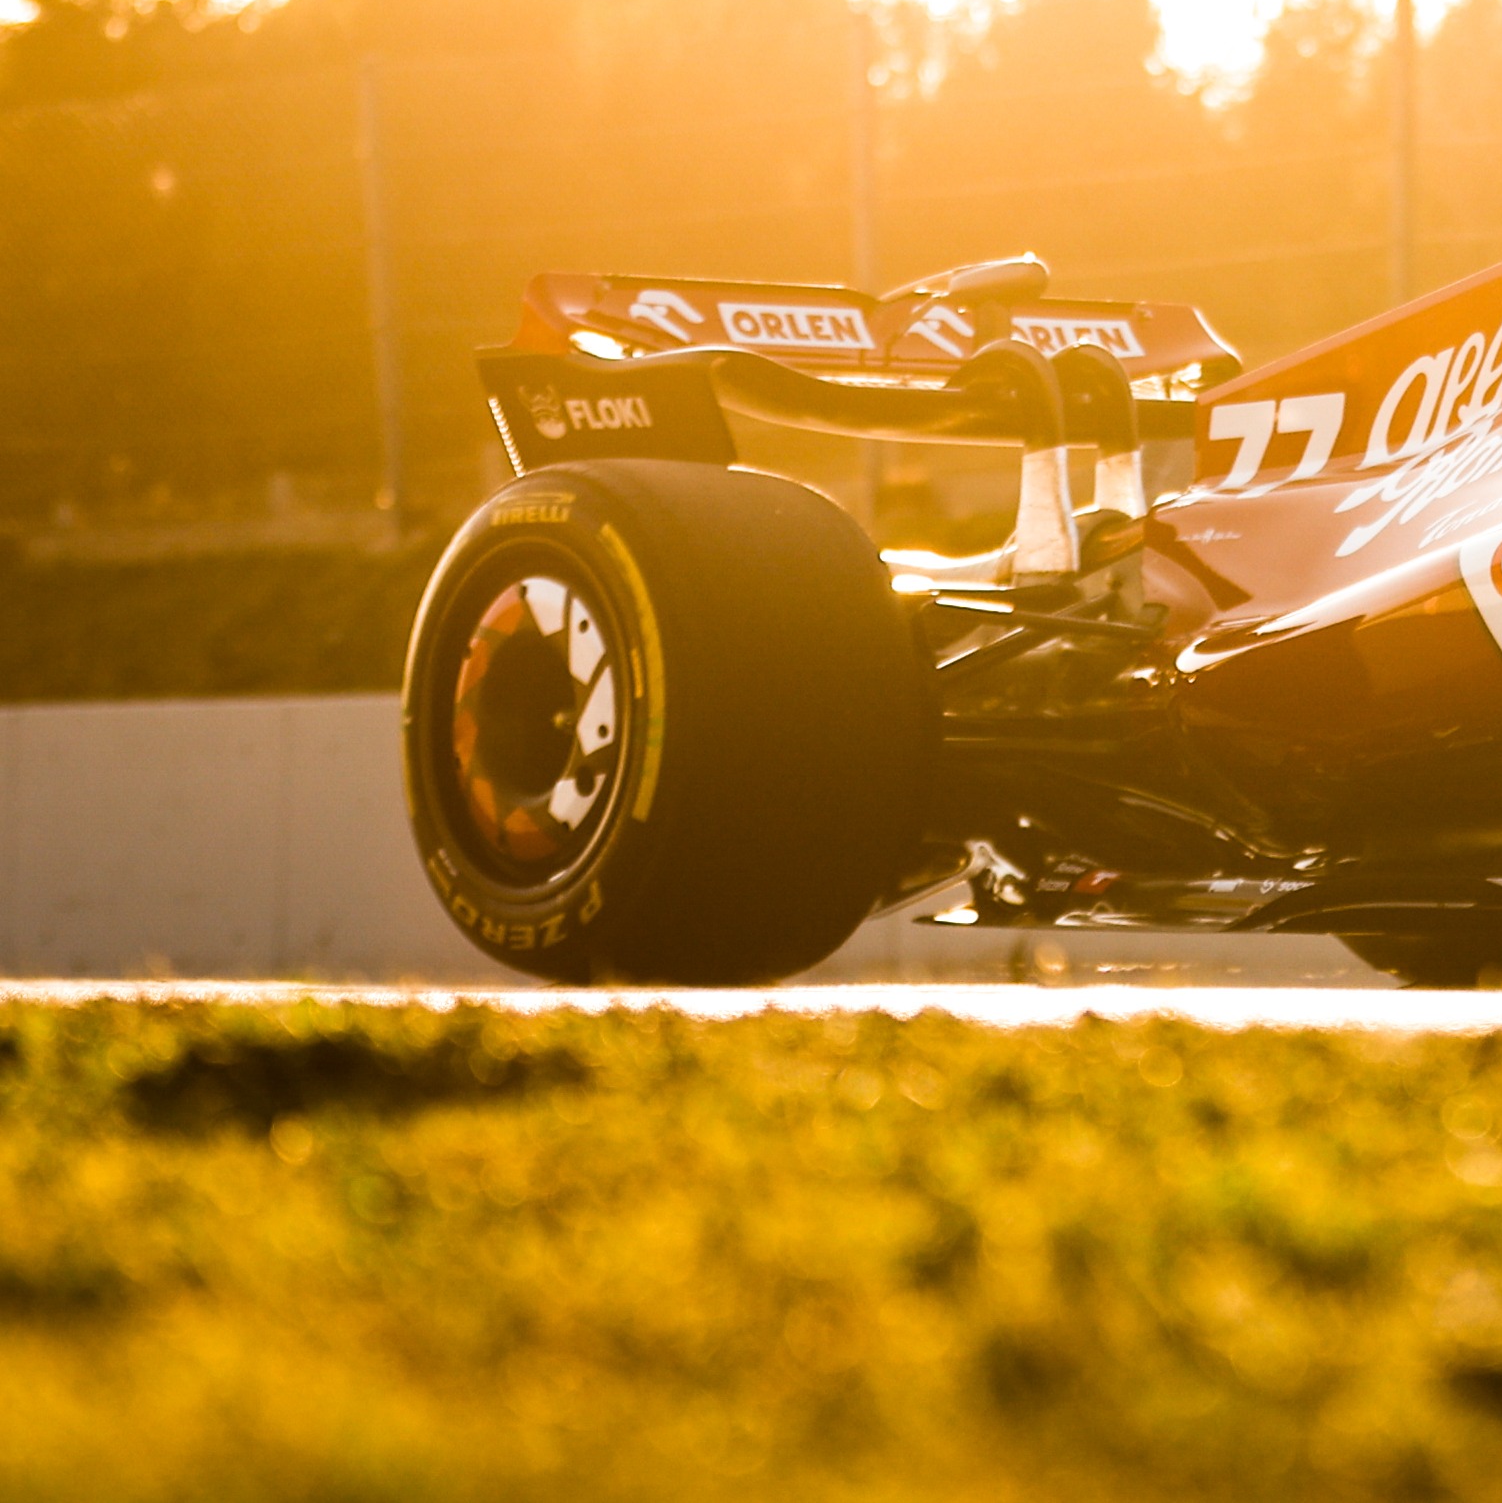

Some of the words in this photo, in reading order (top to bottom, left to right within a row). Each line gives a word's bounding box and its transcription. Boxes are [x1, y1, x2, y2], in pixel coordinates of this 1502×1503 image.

[730, 309, 863, 343] ORLEN
[565, 397, 654, 430] FLOKI
[1208, 392, 1346, 499] 77
[490, 492, 577, 527] PIRELLI
[451, 895, 568, 950] ZERO
[579, 880, 603, 925] P
